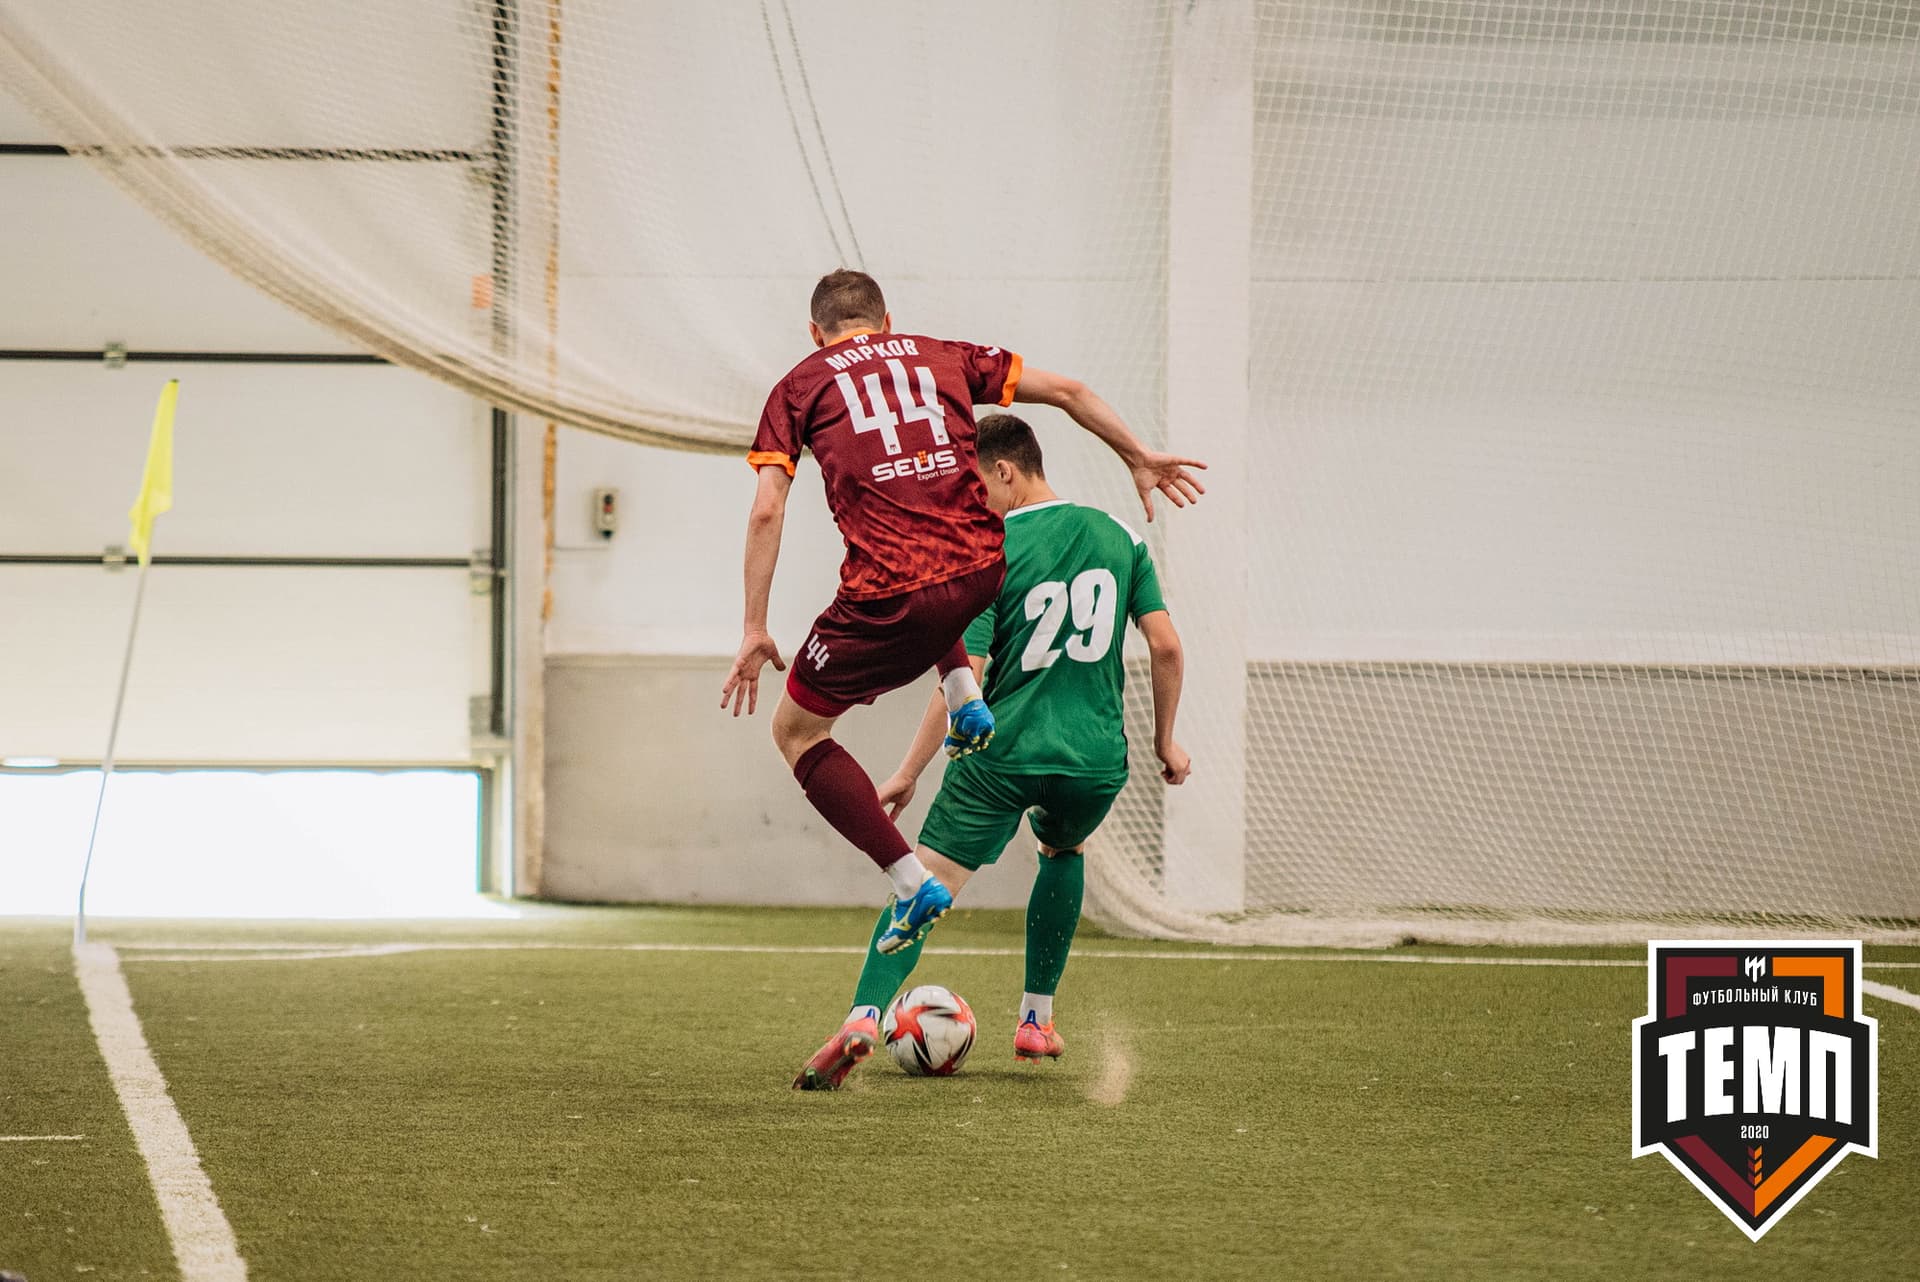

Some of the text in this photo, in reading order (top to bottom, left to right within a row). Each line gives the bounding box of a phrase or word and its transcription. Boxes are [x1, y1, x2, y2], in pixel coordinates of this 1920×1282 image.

[825, 338, 919, 372] МАРКОВ
[834, 358, 951, 457] 44
[917, 466, 960, 481] Export Union
[1021, 568, 1118, 672] 29
[806, 633, 830, 672] 44
